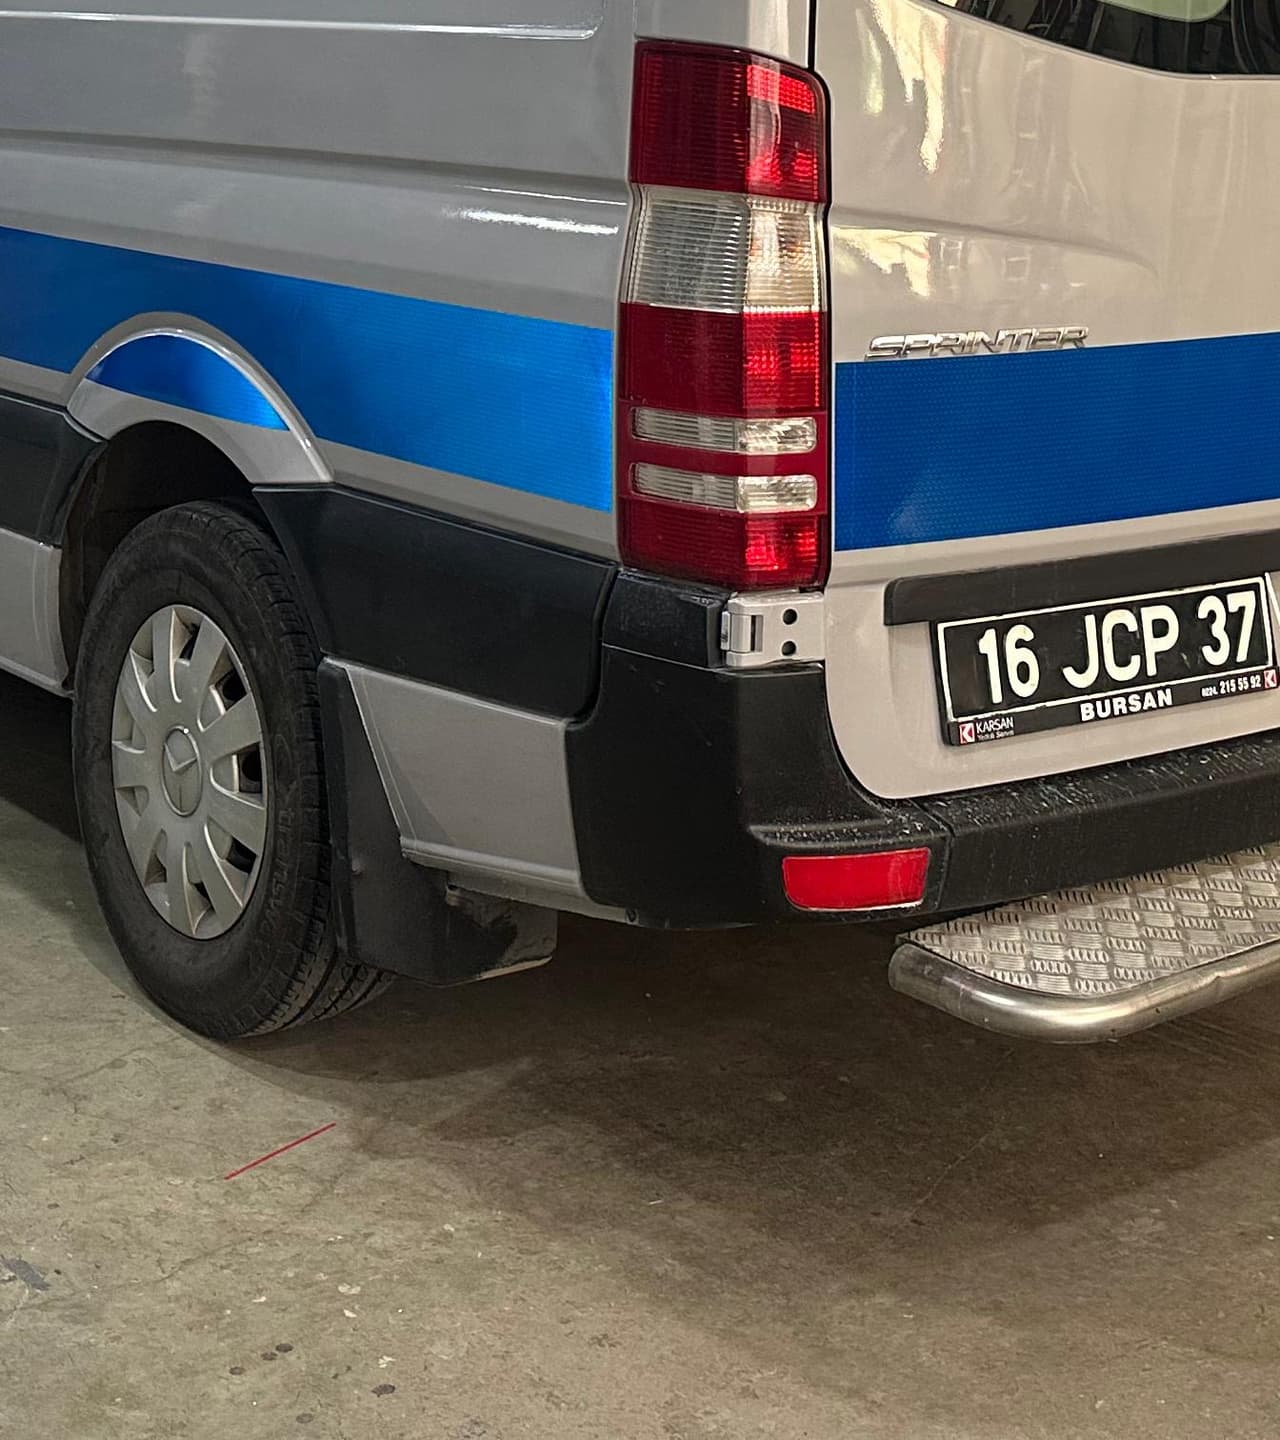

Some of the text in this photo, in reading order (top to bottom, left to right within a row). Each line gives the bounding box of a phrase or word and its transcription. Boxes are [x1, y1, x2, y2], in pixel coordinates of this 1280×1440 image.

[863, 325, 1090, 361] SPRINTER
[978, 590, 1257, 704] 16 JCP 37
[1219, 679, 1237, 695] 215
[1237, 676, 1249, 691] 55
[1250, 674, 1261, 689] 92
[1079, 687, 1173, 722] BURSAN
[976, 716, 1015, 734] KARSAN
